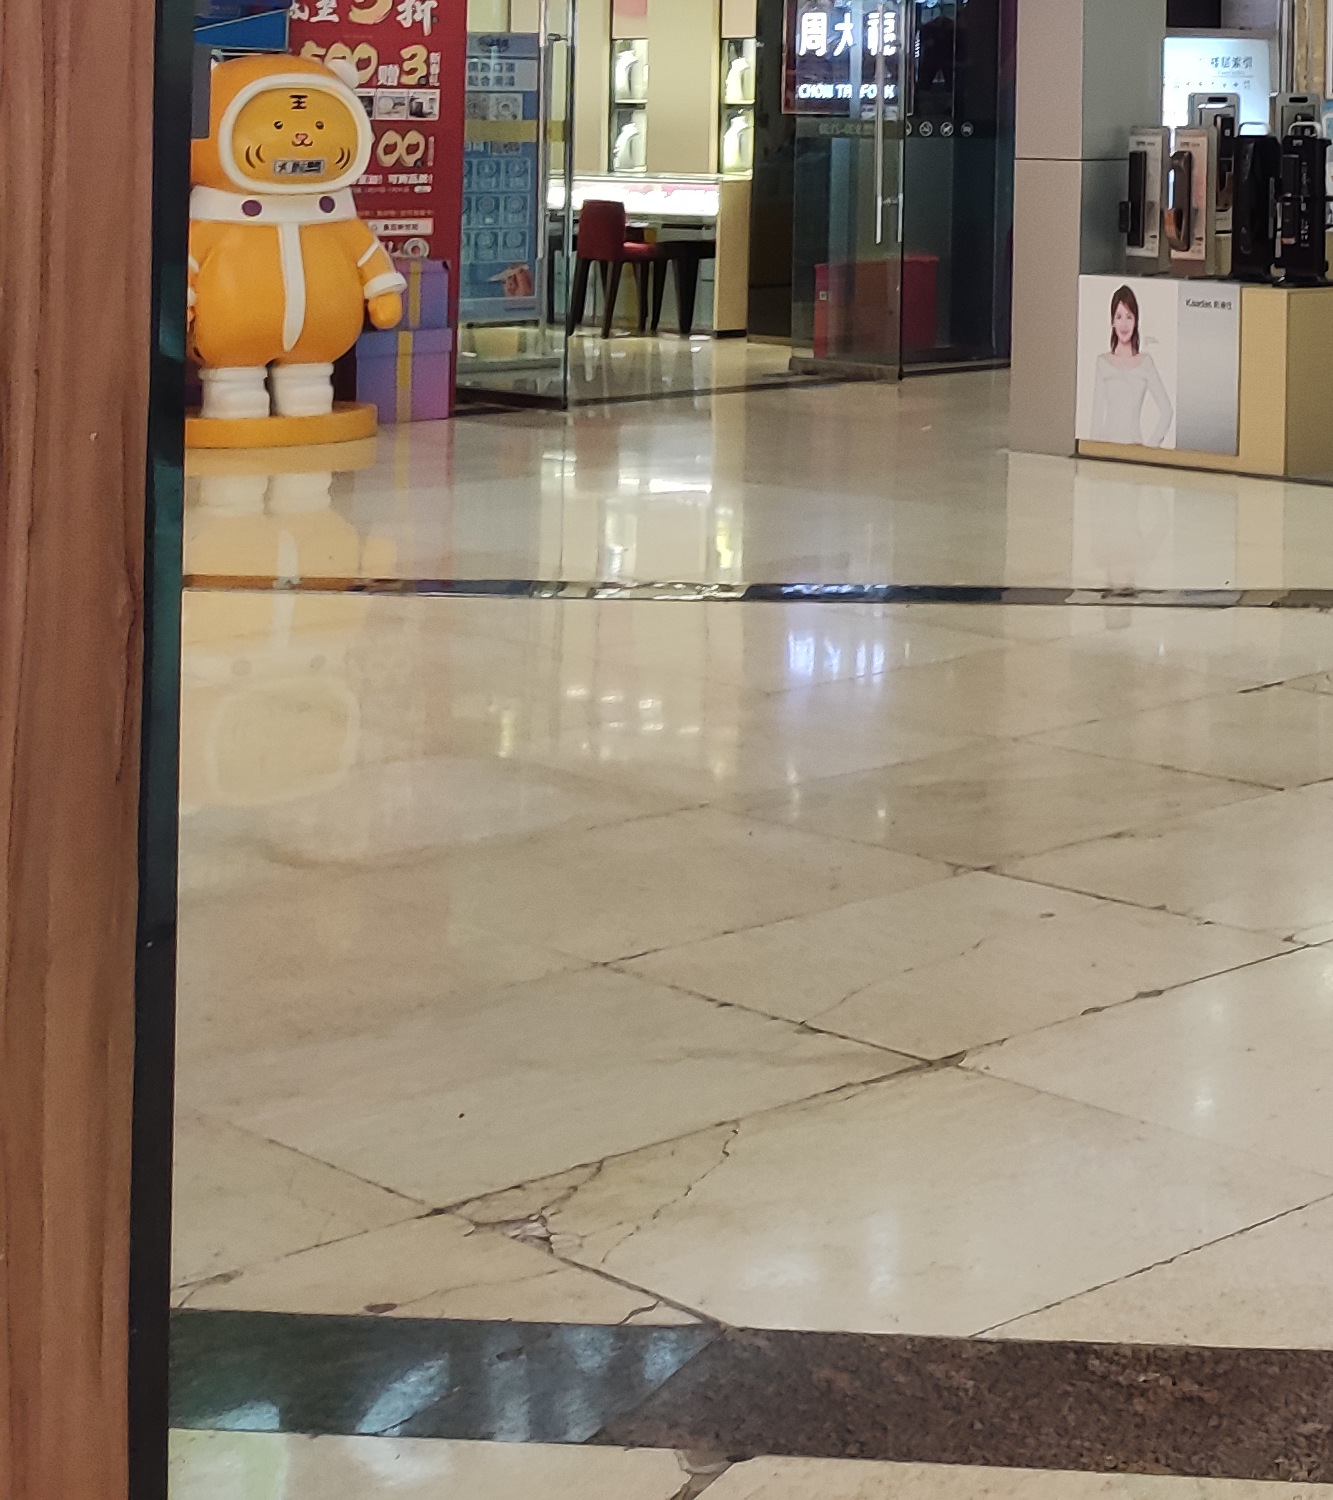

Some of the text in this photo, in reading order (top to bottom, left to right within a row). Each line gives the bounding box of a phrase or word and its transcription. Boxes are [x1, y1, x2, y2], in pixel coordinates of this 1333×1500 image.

[798, 12, 897, 57] 周大福
[400, 45, 428, 85] 3
[836, 83, 852, 99] TA
[859, 83, 897, 99] FOK
